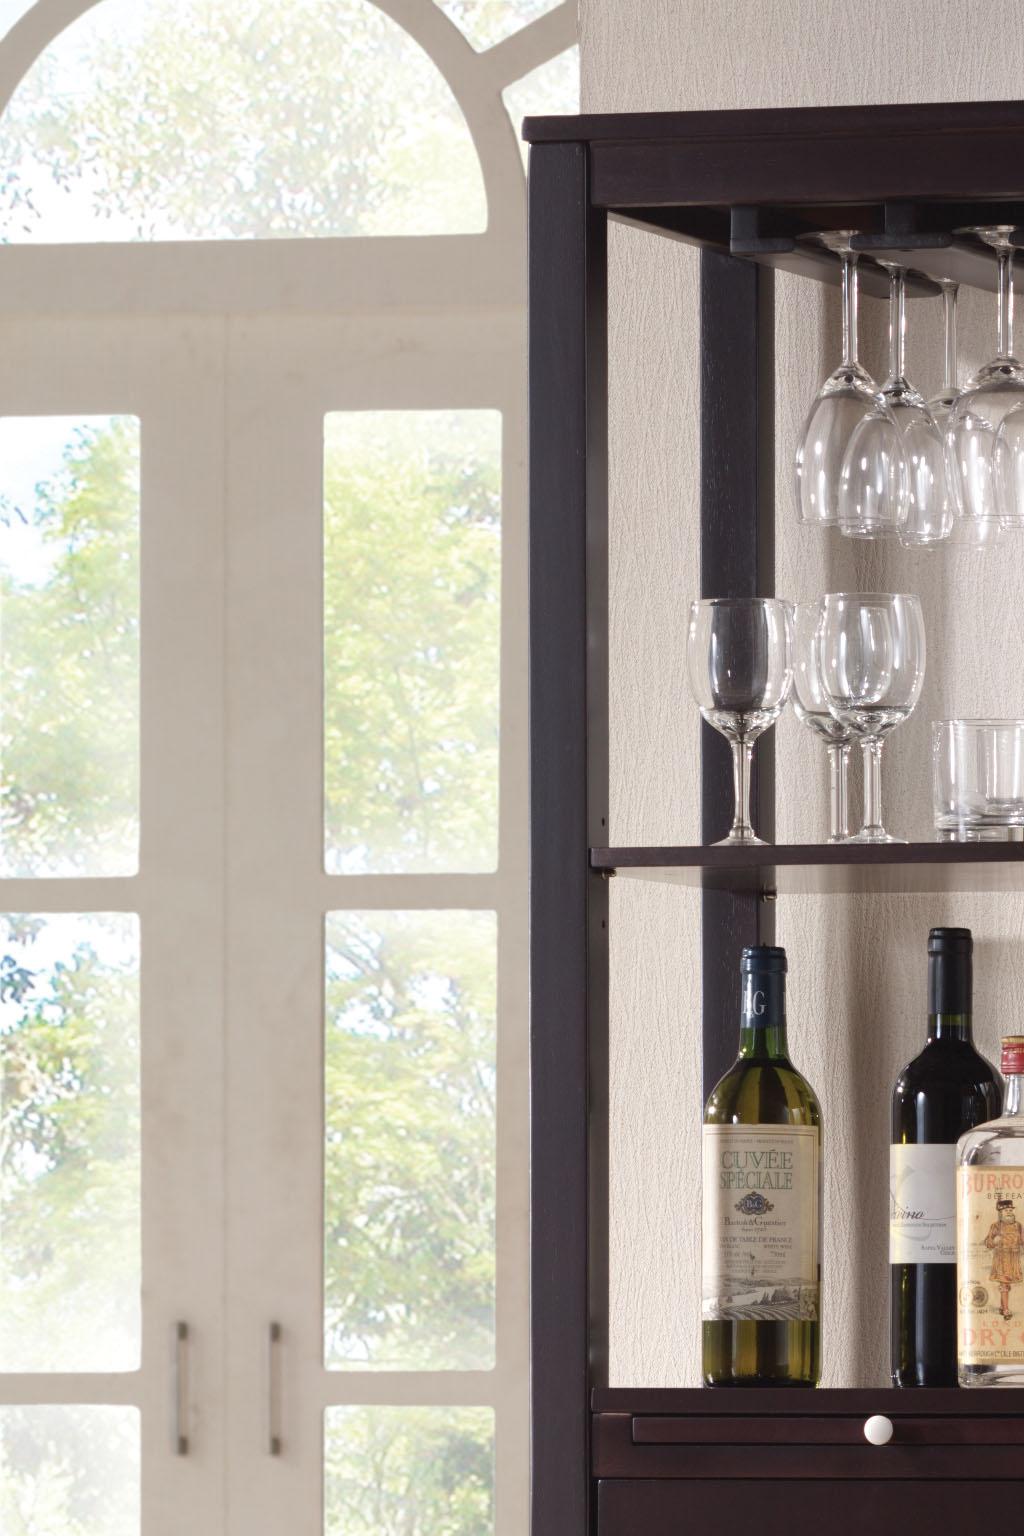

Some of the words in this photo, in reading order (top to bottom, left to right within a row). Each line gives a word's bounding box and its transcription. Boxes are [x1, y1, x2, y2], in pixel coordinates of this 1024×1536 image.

[721, 1148, 793, 1169] CUVÉE
[719, 1169, 793, 1190] SPÉCIALE
[963, 1328, 1011, 1346] DRY
